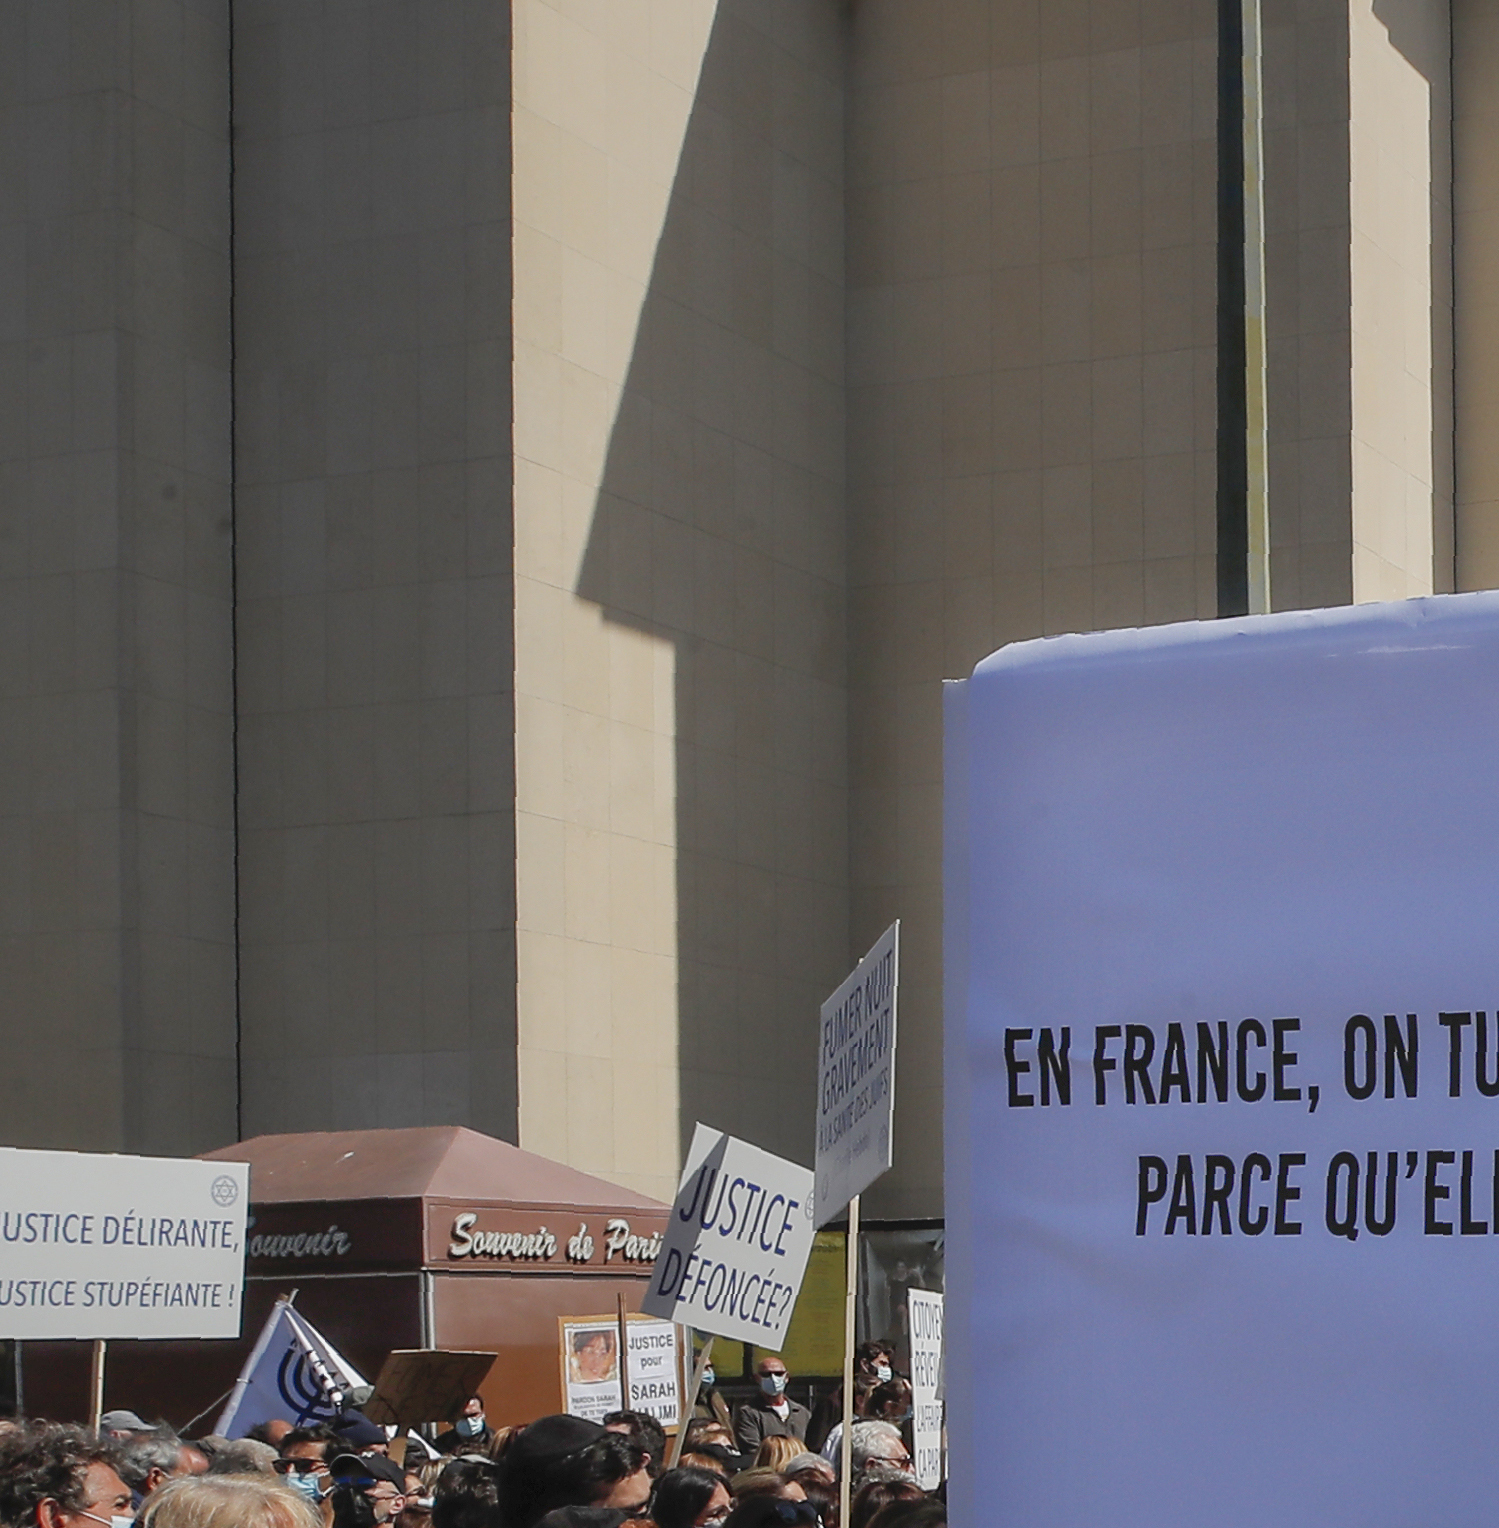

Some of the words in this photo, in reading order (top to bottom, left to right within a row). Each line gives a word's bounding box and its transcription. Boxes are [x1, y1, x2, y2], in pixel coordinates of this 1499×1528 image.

[824, 985, 862, 1066] FUMER
[865, 949, 892, 1021] NUIT
[822, 1007, 890, 1115] GRAVEMENT
[1003, 1025, 1071, 1108] EN
[1092, 1017, 1320, 1114] FRANCE,
[1343, 1013, 1419, 1101] ON
[680, 1165, 799, 1256] JUSTICE
[1135, 1152, 1307, 1237] PARCE
[0, 1212, 95, 1244] USTICE
[102, 1208, 239, 1253] DÉLIRANTE,
[250, 1222, 351, 1258] ouvenir
[450, 1212, 557, 1259] Souvenir
[567, 1222, 594, 1263] de
[604, 1218, 665, 1262] Pari
[0, 1280, 78, 1306] USTICE
[82, 1277, 223, 1308] STUPÉFIANTE
[657, 1244, 793, 1331] DÉFONCÉE?
[628, 1334, 674, 1350] JUSTICE
[640, 1356, 663, 1370] pour
[631, 1381, 676, 1401] SARAH
